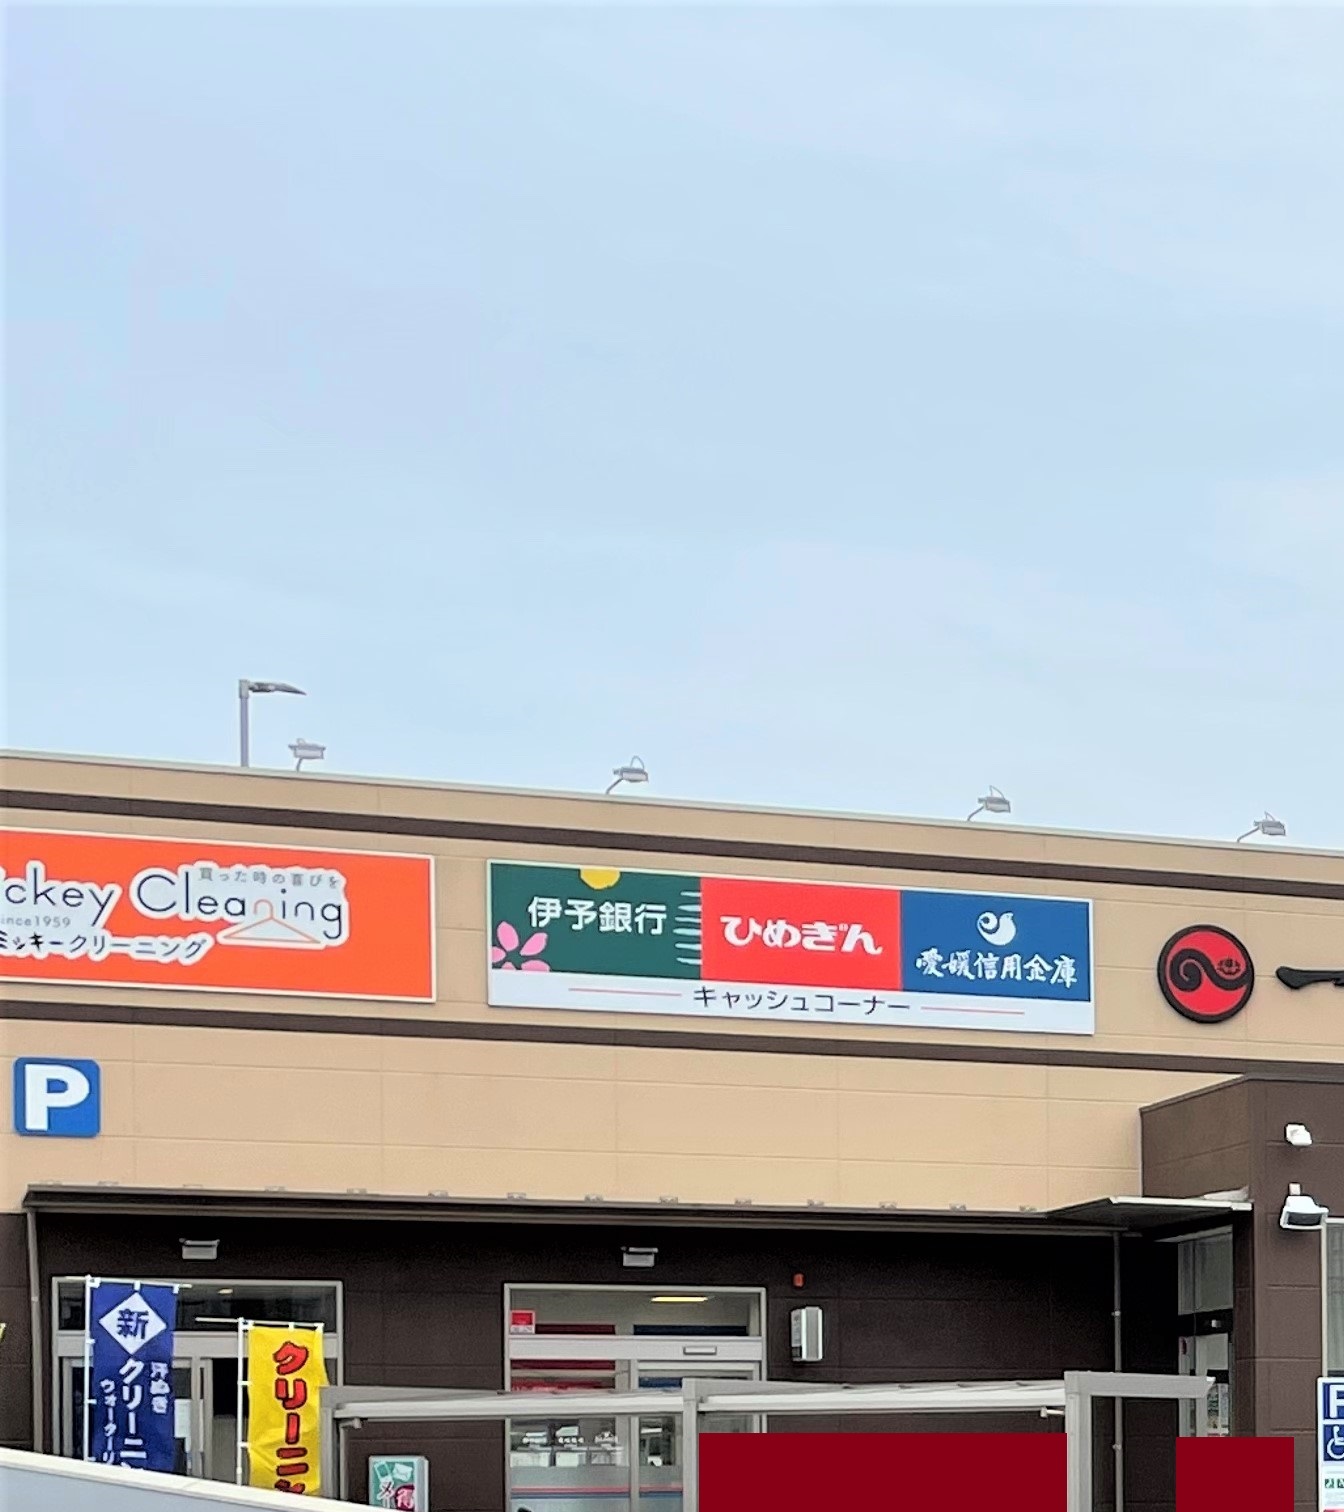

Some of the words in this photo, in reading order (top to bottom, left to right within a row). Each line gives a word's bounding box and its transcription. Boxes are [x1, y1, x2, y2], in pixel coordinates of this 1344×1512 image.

[0, 915, 71, 928] ince1959
[137, 871, 342, 940] Cleaning
[528, 896, 667, 935] 伊予銀行
[720, 915, 883, 955] ひめぎん
[915, 947, 1079, 989] 愛媛信用金庫
[693, 985, 910, 1016] キャッシュコーナー
[25, 1063, 89, 1131] P
[117, 1308, 149, 1340] 新
